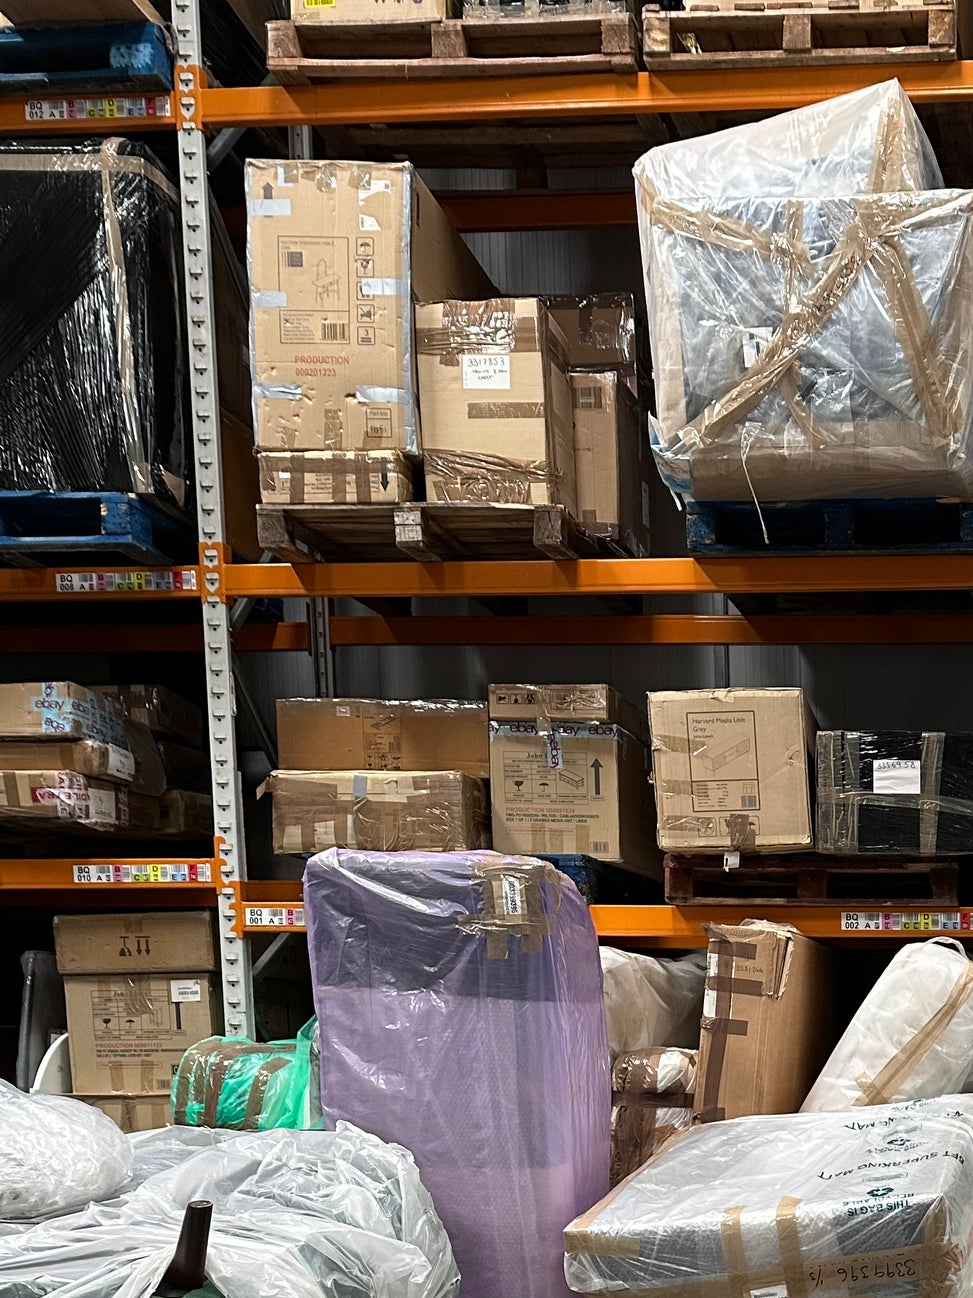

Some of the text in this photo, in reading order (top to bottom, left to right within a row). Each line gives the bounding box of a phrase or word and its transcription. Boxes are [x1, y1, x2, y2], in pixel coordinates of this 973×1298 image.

[29, 102, 43, 110] BQ
[295, 356, 349, 365] PRODUCTION
[296, 368, 336, 376] 000201223
[60, 574, 73, 583] BQ
[35, 698, 90, 714] ebay eba
[510, 723, 618, 737] ebay ebay
[547, 734, 560, 768] ebay
[857, 1152, 938, 1170] SUPERKING
[847, 1200, 909, 1217] THIS BAG IS
[837, 1259, 916, 1282] 3399396
